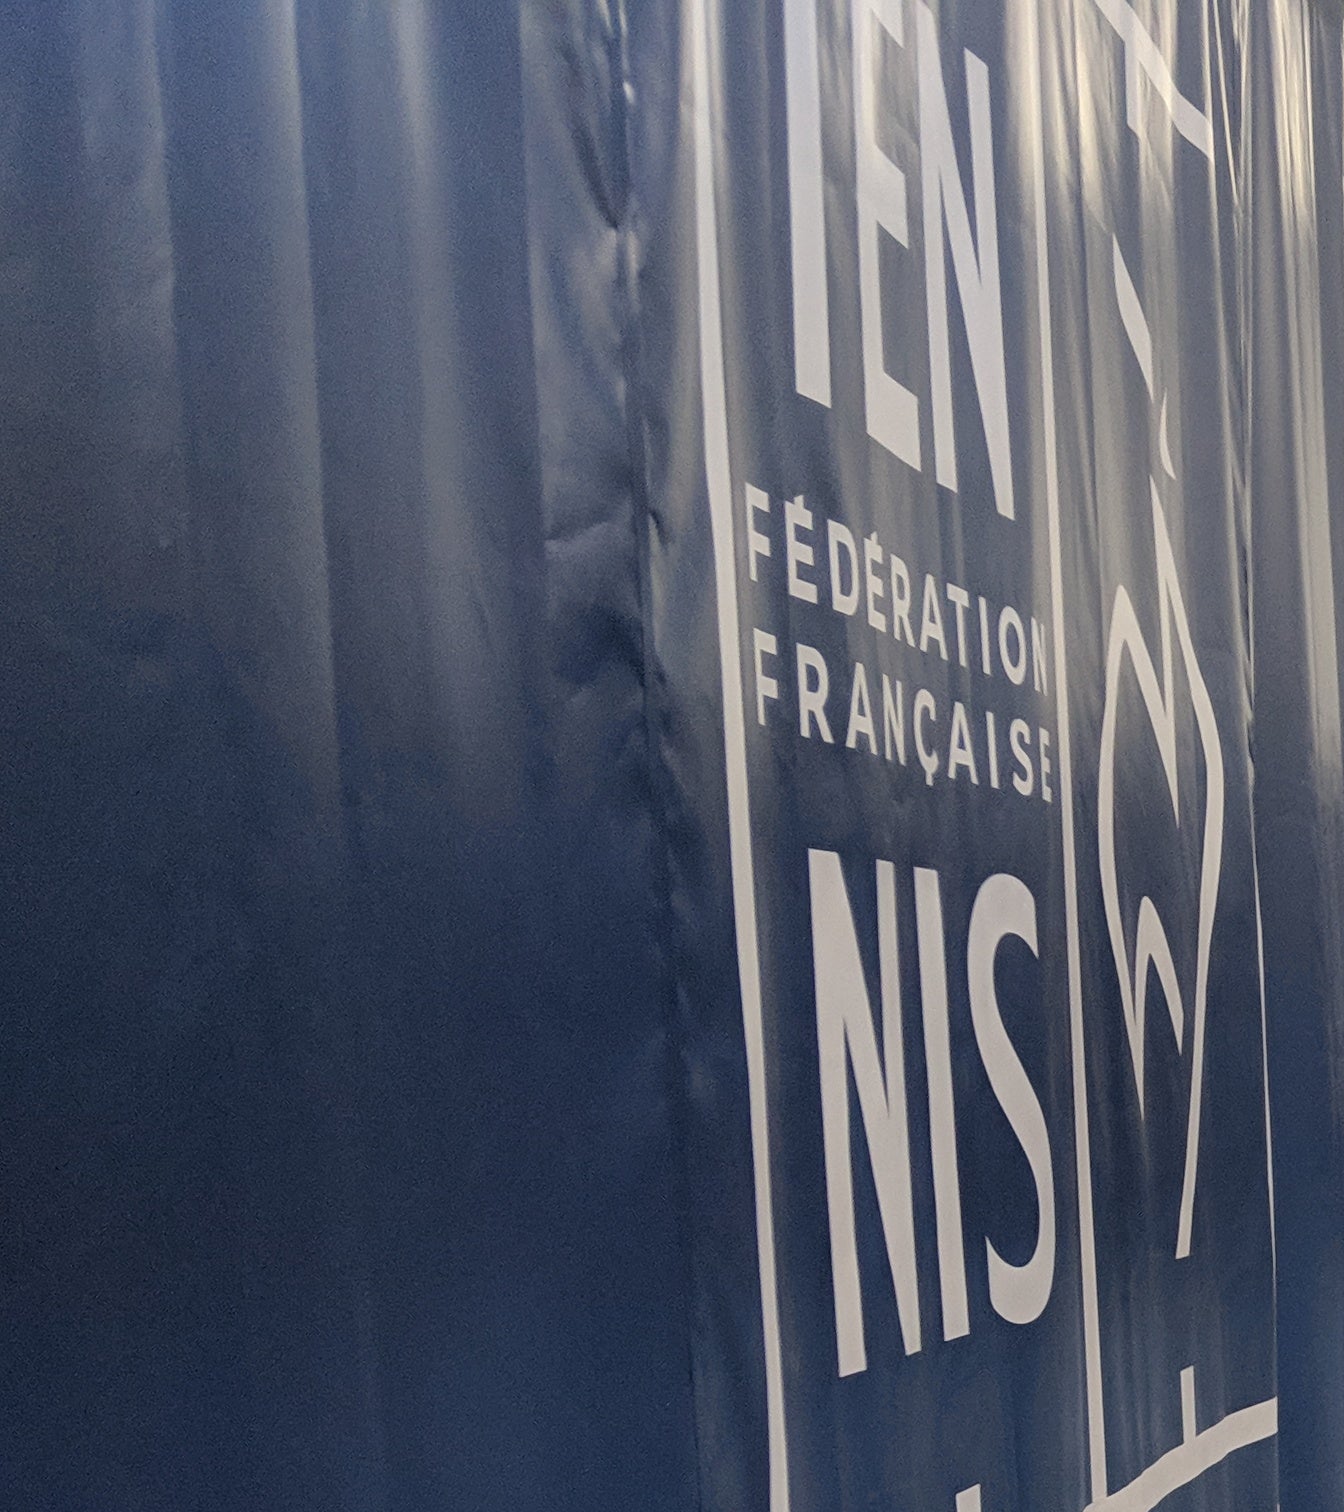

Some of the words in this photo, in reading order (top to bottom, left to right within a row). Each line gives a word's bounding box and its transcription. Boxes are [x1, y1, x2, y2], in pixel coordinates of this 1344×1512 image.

[745, 482, 1048, 697] FÉDÉRATION
[753, 628, 1053, 804] FRANÇAISE
[808, 848, 1056, 1378] NIS
